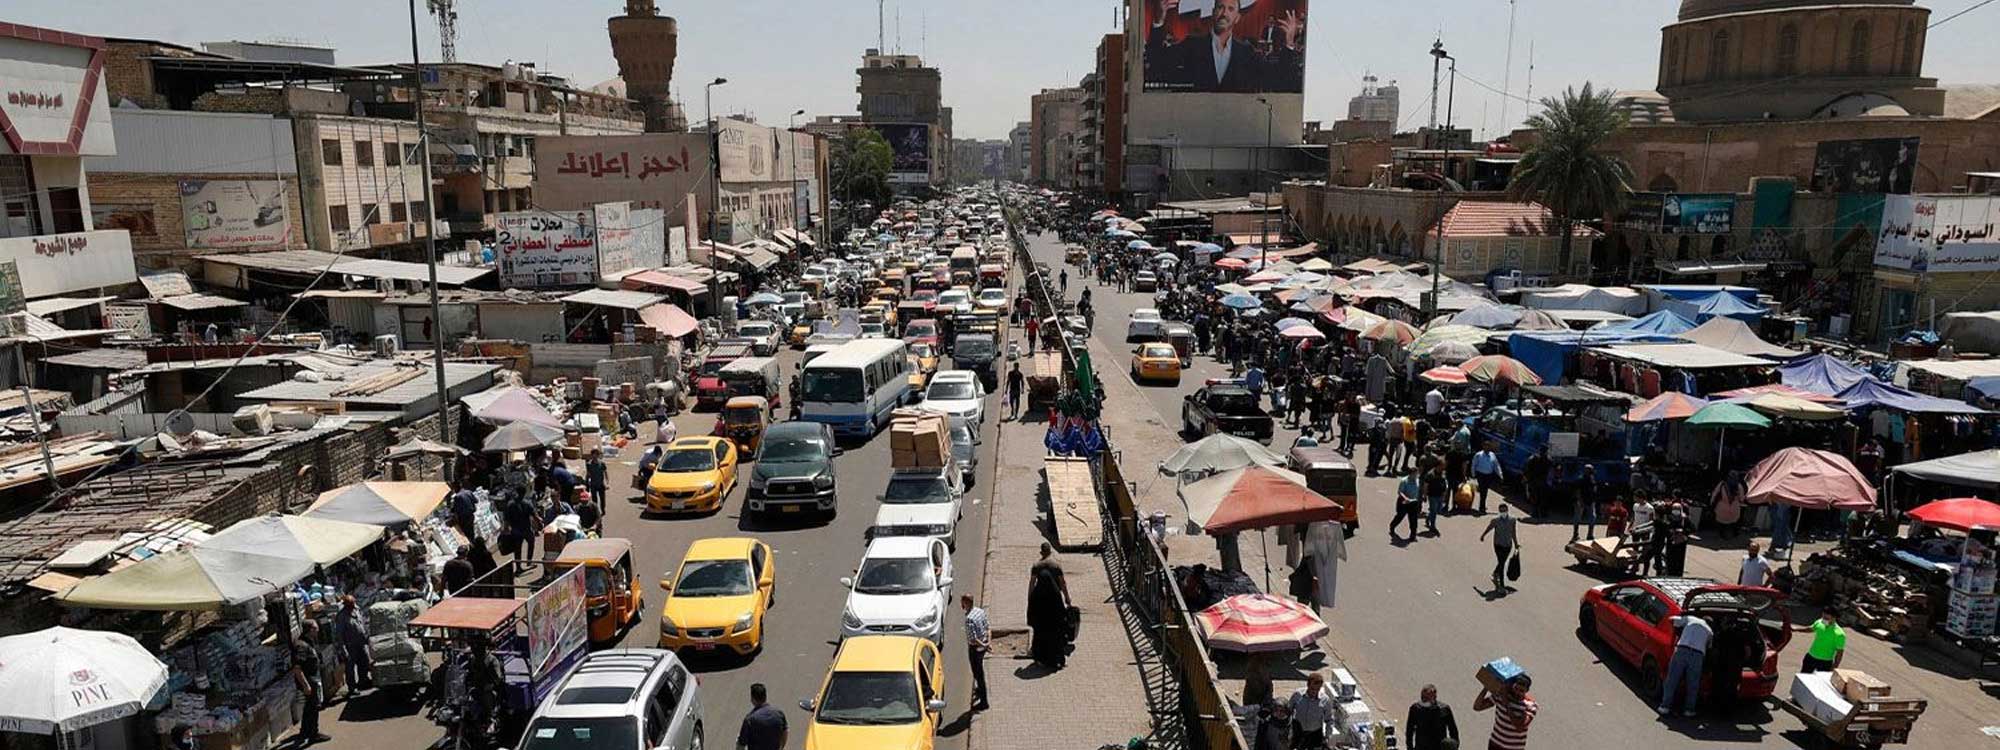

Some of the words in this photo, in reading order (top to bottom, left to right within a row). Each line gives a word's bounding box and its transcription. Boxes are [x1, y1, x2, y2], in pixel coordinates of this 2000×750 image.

[557, 152, 630, 179] إعلانك
[530, 216, 564, 232] محلات
[68, 236, 88, 256] مجمع
[500, 231, 511, 244] 2
[1936, 223, 1994, 251] السوداني
[72, 683, 112, 707] PINE
[0, 719, 23, 731] PINE
